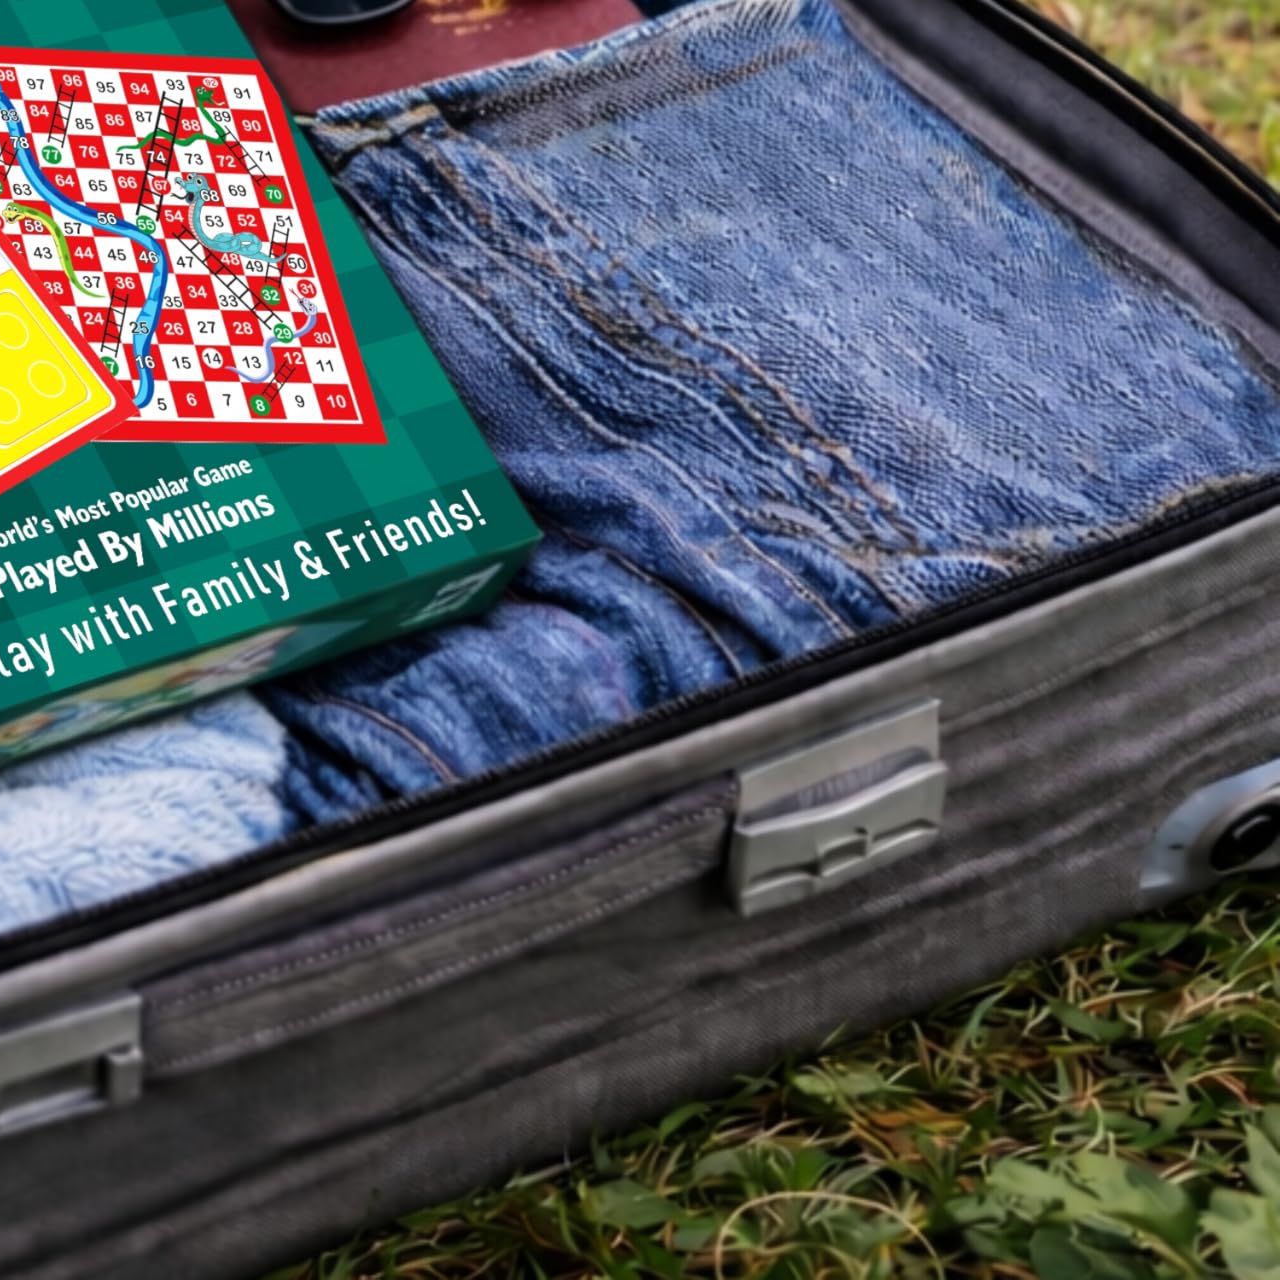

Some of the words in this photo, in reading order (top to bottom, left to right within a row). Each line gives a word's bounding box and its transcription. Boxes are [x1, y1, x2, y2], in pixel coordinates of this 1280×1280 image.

[26, 78, 45, 90] 97
[62, 74, 83, 87] 96
[96, 81, 116, 94] 95
[129, 82, 150, 95] 94
[166, 78, 185, 91] 93
[203, 78, 218, 88] 92
[233, 87, 251, 99] 91
[0, 110, 20, 122] 83
[29, 104, 49, 117] 84
[75, 118, 94, 130] 85
[104, 114, 124, 126] 86
[135, 111, 153, 123] 87
[181, 119, 201, 132] 88
[213, 110, 232, 123] 89
[242, 119, 262, 132] 90
[10, 136, 30, 149] 78
[42, 148, 60, 161] 77
[78, 146, 99, 158] 76
[115, 153, 135, 165] 75
[146, 151, 166, 163] 74
[184, 153, 204, 165] 73
[216, 155, 237, 168] 72
[256, 150, 273, 162] 71
[13, 183, 32, 196] 63
[54, 174, 75, 187] 64
[88, 179, 108, 192] 65
[117, 176, 137, 189] 66
[153, 179, 170, 191] 67
[200, 189, 220, 202] 68
[228, 184, 247, 197] 69
[266, 189, 282, 200] 70
[24, 220, 44, 233] 58
[63, 222, 82, 234] 57
[97, 212, 117, 225] 56
[137, 219, 155, 230] 55
[164, 210, 184, 222] 54
[205, 215, 224, 227] 53
[237, 214, 257, 227] 52
[275, 215, 293, 227] 51
[33, 247, 53, 259] 43
[74, 246, 94, 259] 44
[107, 249, 126, 261] 45
[139, 251, 159, 264] 46
[176, 256, 194, 268] 47
[220, 253, 240, 266] 48
[245, 260, 264, 272] 49
[287, 257, 307, 270] 50
[43, 281, 64, 295] 38
[82, 276, 101, 288] 37
[115, 276, 135, 289] 36
[164, 296, 183, 308] 35
[186, 285, 207, 299] 34
[219, 295, 239, 307] 33
[261, 288, 280, 301] 32
[299, 283, 315, 295] 31
[83, 312, 104, 325] 24
[129, 321, 149, 334] 25
[163, 322, 184, 335] 26
[197, 321, 216, 334] 27
[233, 321, 253, 335] 28
[274, 327, 292, 339] 29
[313, 332, 332, 344] 30
[136, 355, 156, 369] 16
[171, 356, 192, 369] 15
[204, 352, 221, 364] 14
[242, 356, 261, 369] 13
[283, 352, 304, 365] 12
[316, 359, 334, 372] 11
[157, 398, 167, 411] 5
[186, 392, 197, 406] 6
[222, 393, 231, 406] 7
[255, 399, 266, 411] 8
[295, 395, 305, 407] 9
[326, 394, 346, 408] 10
[54, 500, 111, 529] Most
[109, 477, 189, 513] Popular
[193, 459, 253, 487] Game
[97, 530, 144, 567] By
[146, 494, 275, 549] Millions
[60, 596, 153, 654] with
[152, 557, 290, 625] Family
[293, 540, 330, 580] &
[325, 488, 488, 569] Friends!
